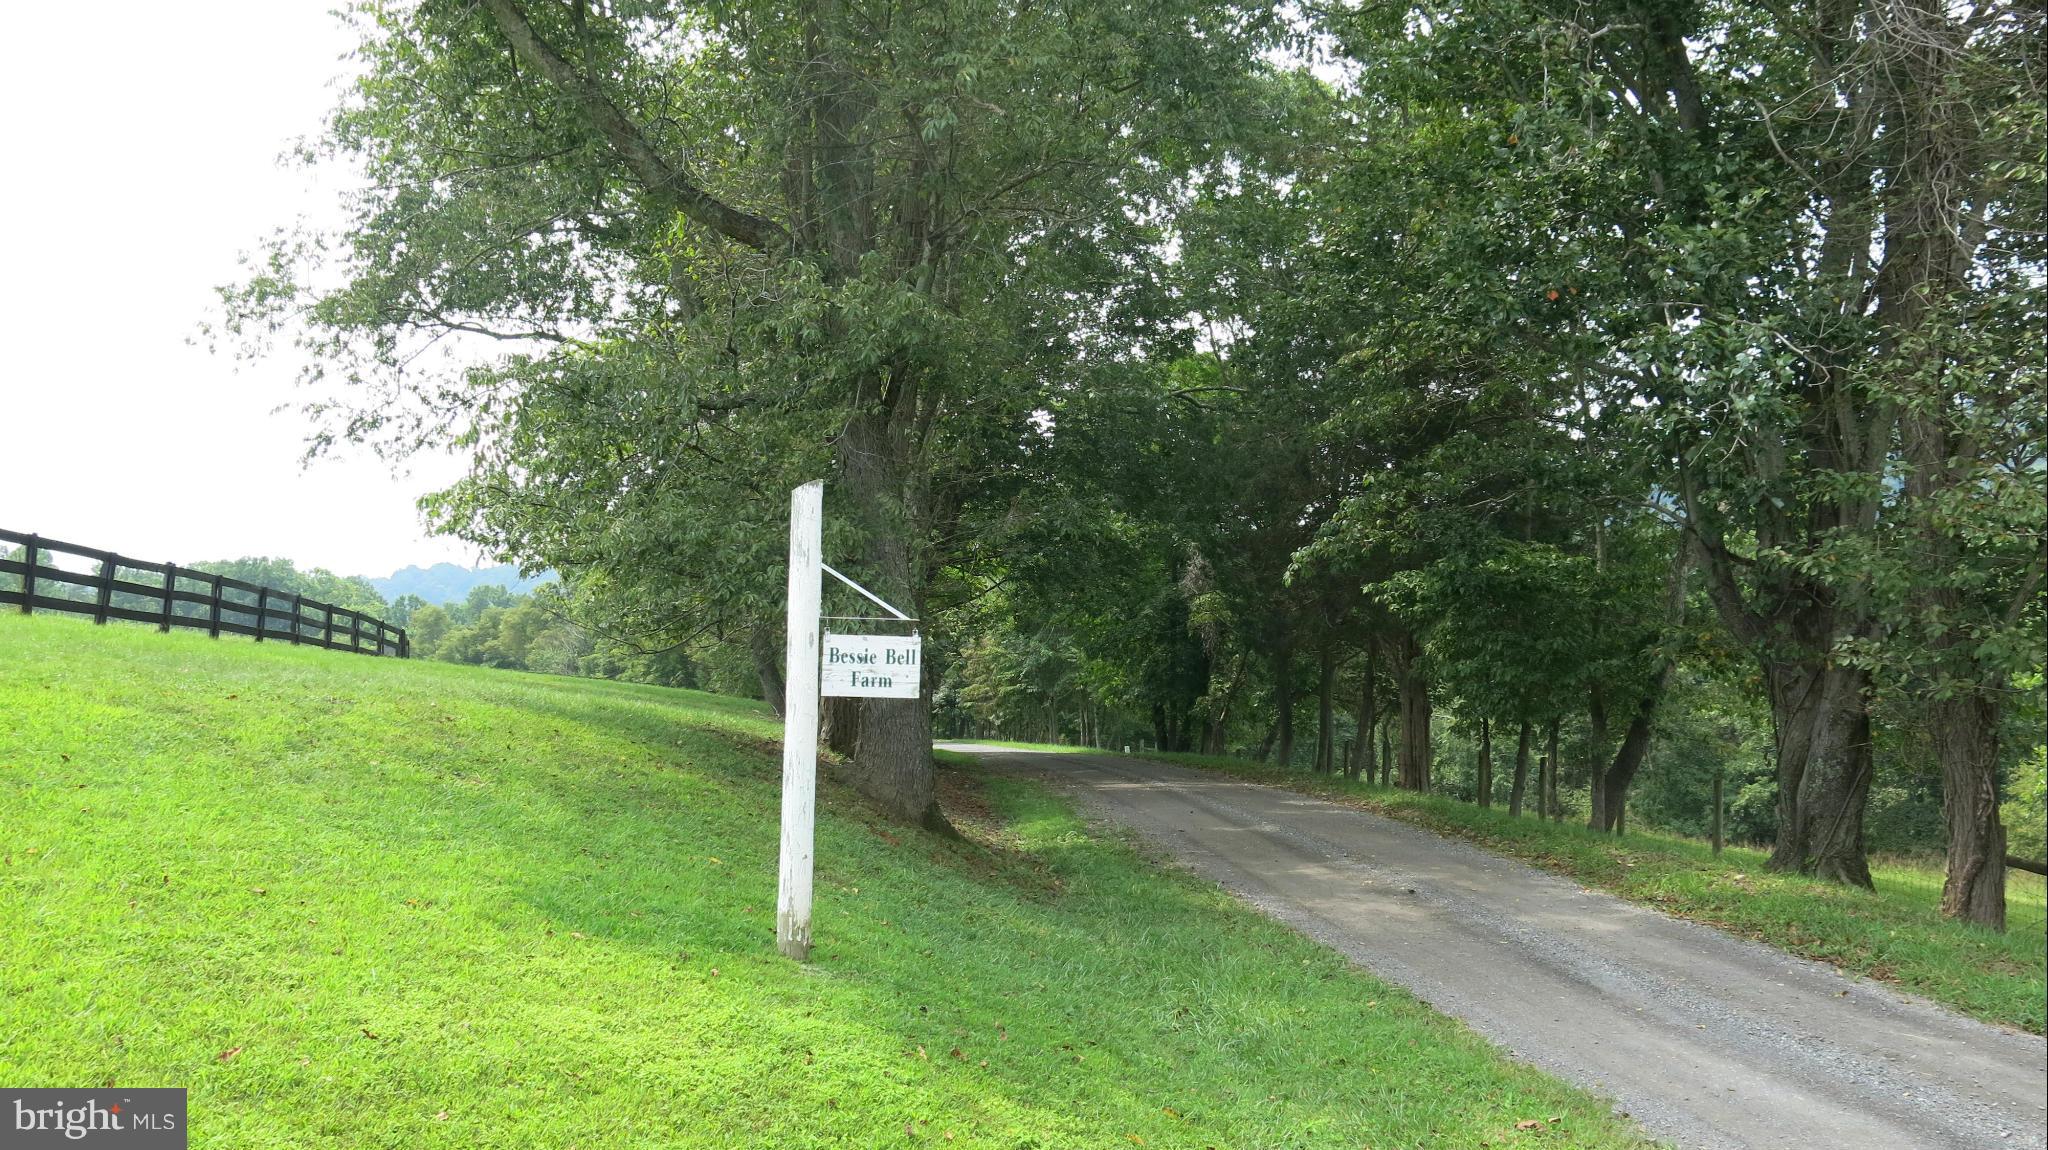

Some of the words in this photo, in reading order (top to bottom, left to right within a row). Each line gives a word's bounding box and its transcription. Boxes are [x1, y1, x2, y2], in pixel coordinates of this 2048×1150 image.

[829, 647, 877, 665] Bessie
[885, 648, 916, 665] Bell
[851, 671, 892, 688] Farm
